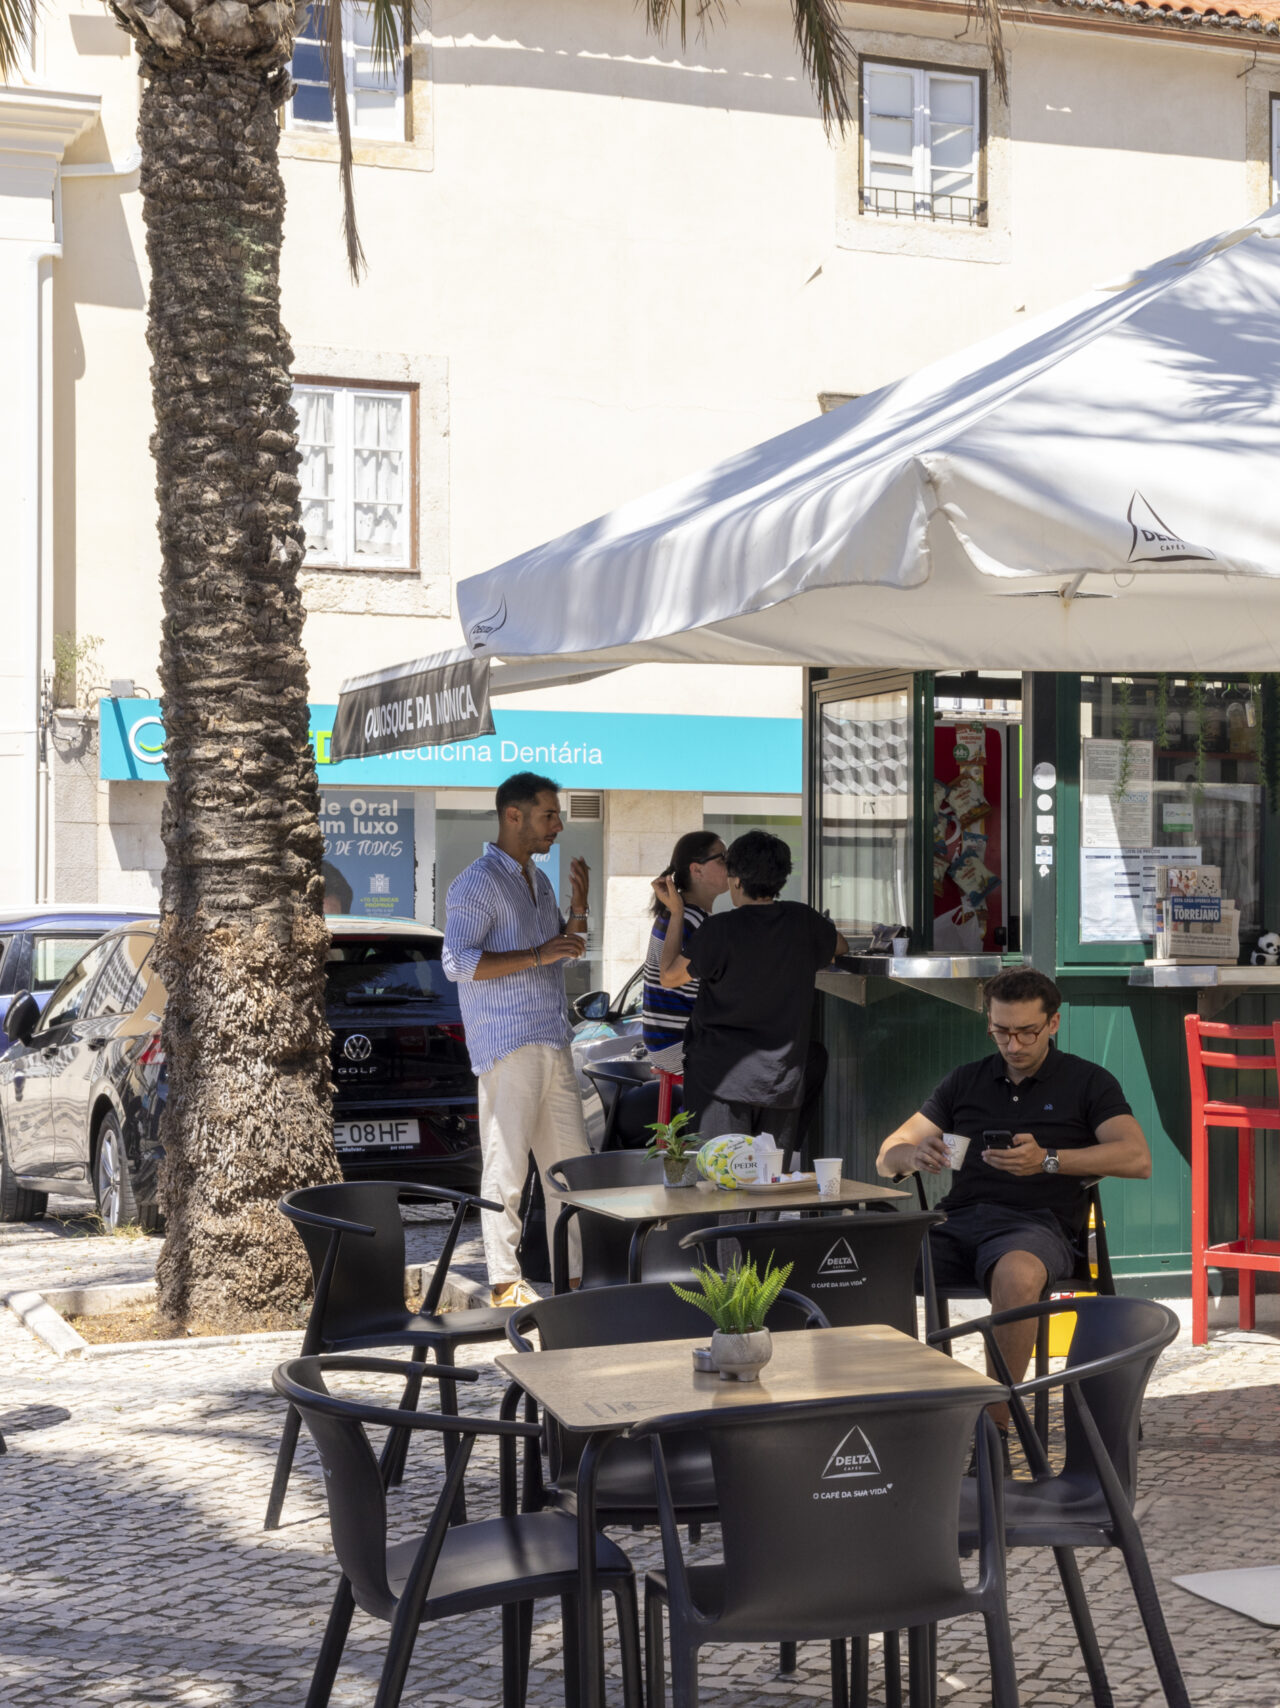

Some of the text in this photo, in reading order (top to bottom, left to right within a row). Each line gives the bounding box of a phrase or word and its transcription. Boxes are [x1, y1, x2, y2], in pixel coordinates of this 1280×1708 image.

[364, 684, 478, 744] QUIOSQUE DA MÓNICA
[500, 740, 603, 764] Dentária
[349, 799, 398, 816] Oral
[353, 817, 399, 835] luxo
[335, 840, 356, 856] DE
[357, 840, 403, 857] TODOS
[1174, 909, 1219, 921] TORREJANO
[734, 1162, 758, 1170] PEDR
[820, 1490, 840, 1499] CAFÉ
[854, 1489, 868, 1497] SUA
[870, 1487, 888, 1495] VIDA
